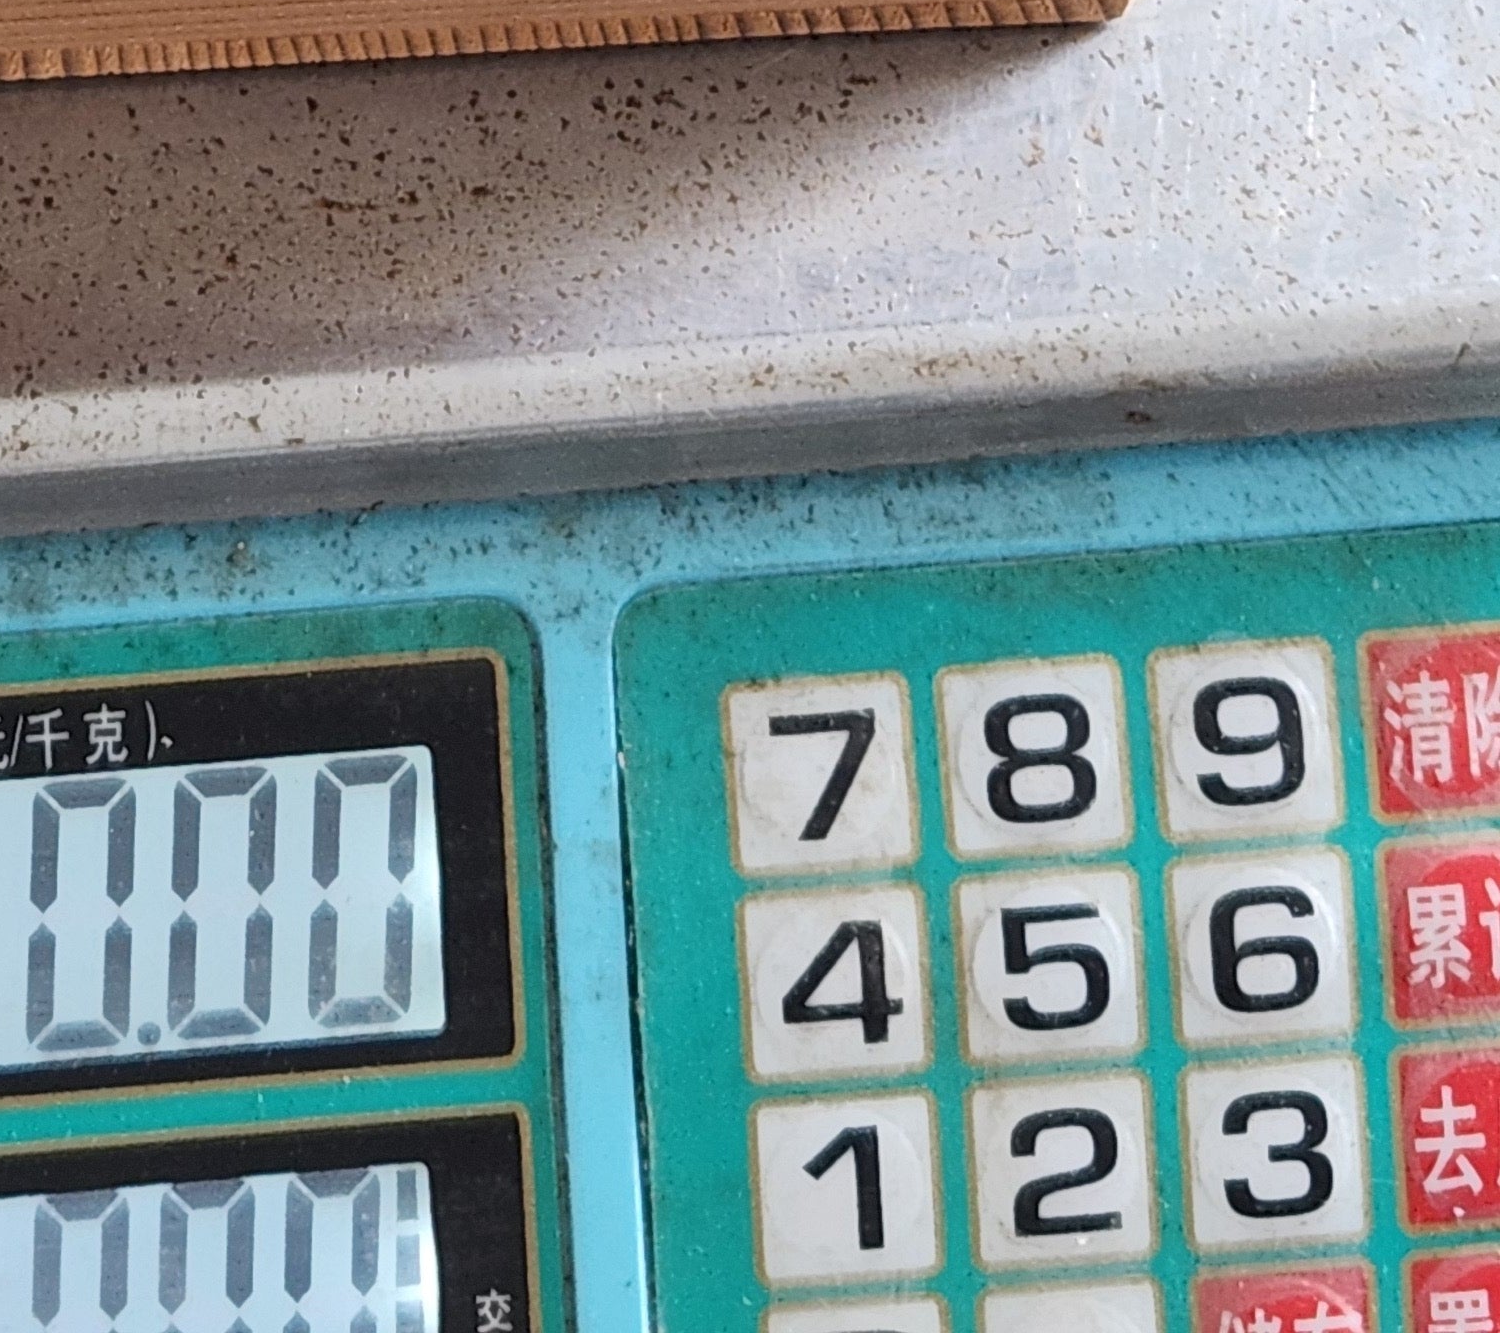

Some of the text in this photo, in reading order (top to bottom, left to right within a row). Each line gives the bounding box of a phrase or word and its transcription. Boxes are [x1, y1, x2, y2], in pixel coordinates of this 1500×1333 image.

[769, 676, 1305, 841] 7 8 9
[26, 753, 418, 1052] 0.00
[782, 886, 1319, 1043] 4 5 6
[802, 1091, 1333, 1251] 1 2 3
[1414, 1085, 1500, 1196] 去
